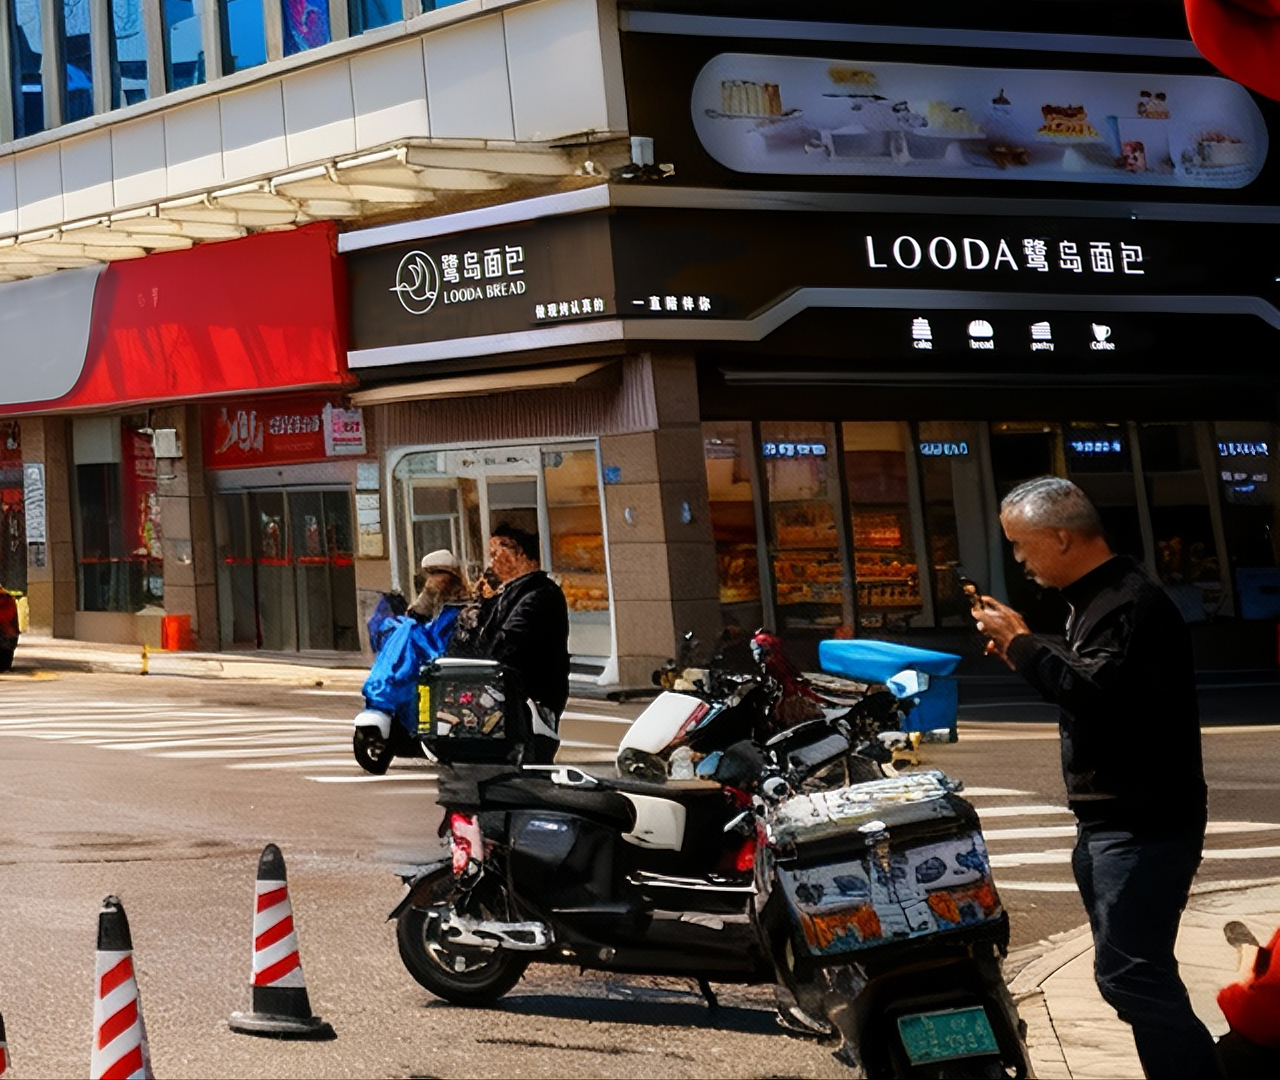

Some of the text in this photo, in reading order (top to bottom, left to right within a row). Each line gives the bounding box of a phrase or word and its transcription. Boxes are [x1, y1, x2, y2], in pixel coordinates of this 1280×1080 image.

[441, 245, 526, 284] 鹭岛面包
[443, 280, 526, 305] LOODA BREAD
[632, 294, 712, 312] 一直陪伴你
[913, 339, 933, 350] cake
[970, 339, 995, 350] bread
[1030, 341, 1055, 352] pastry
